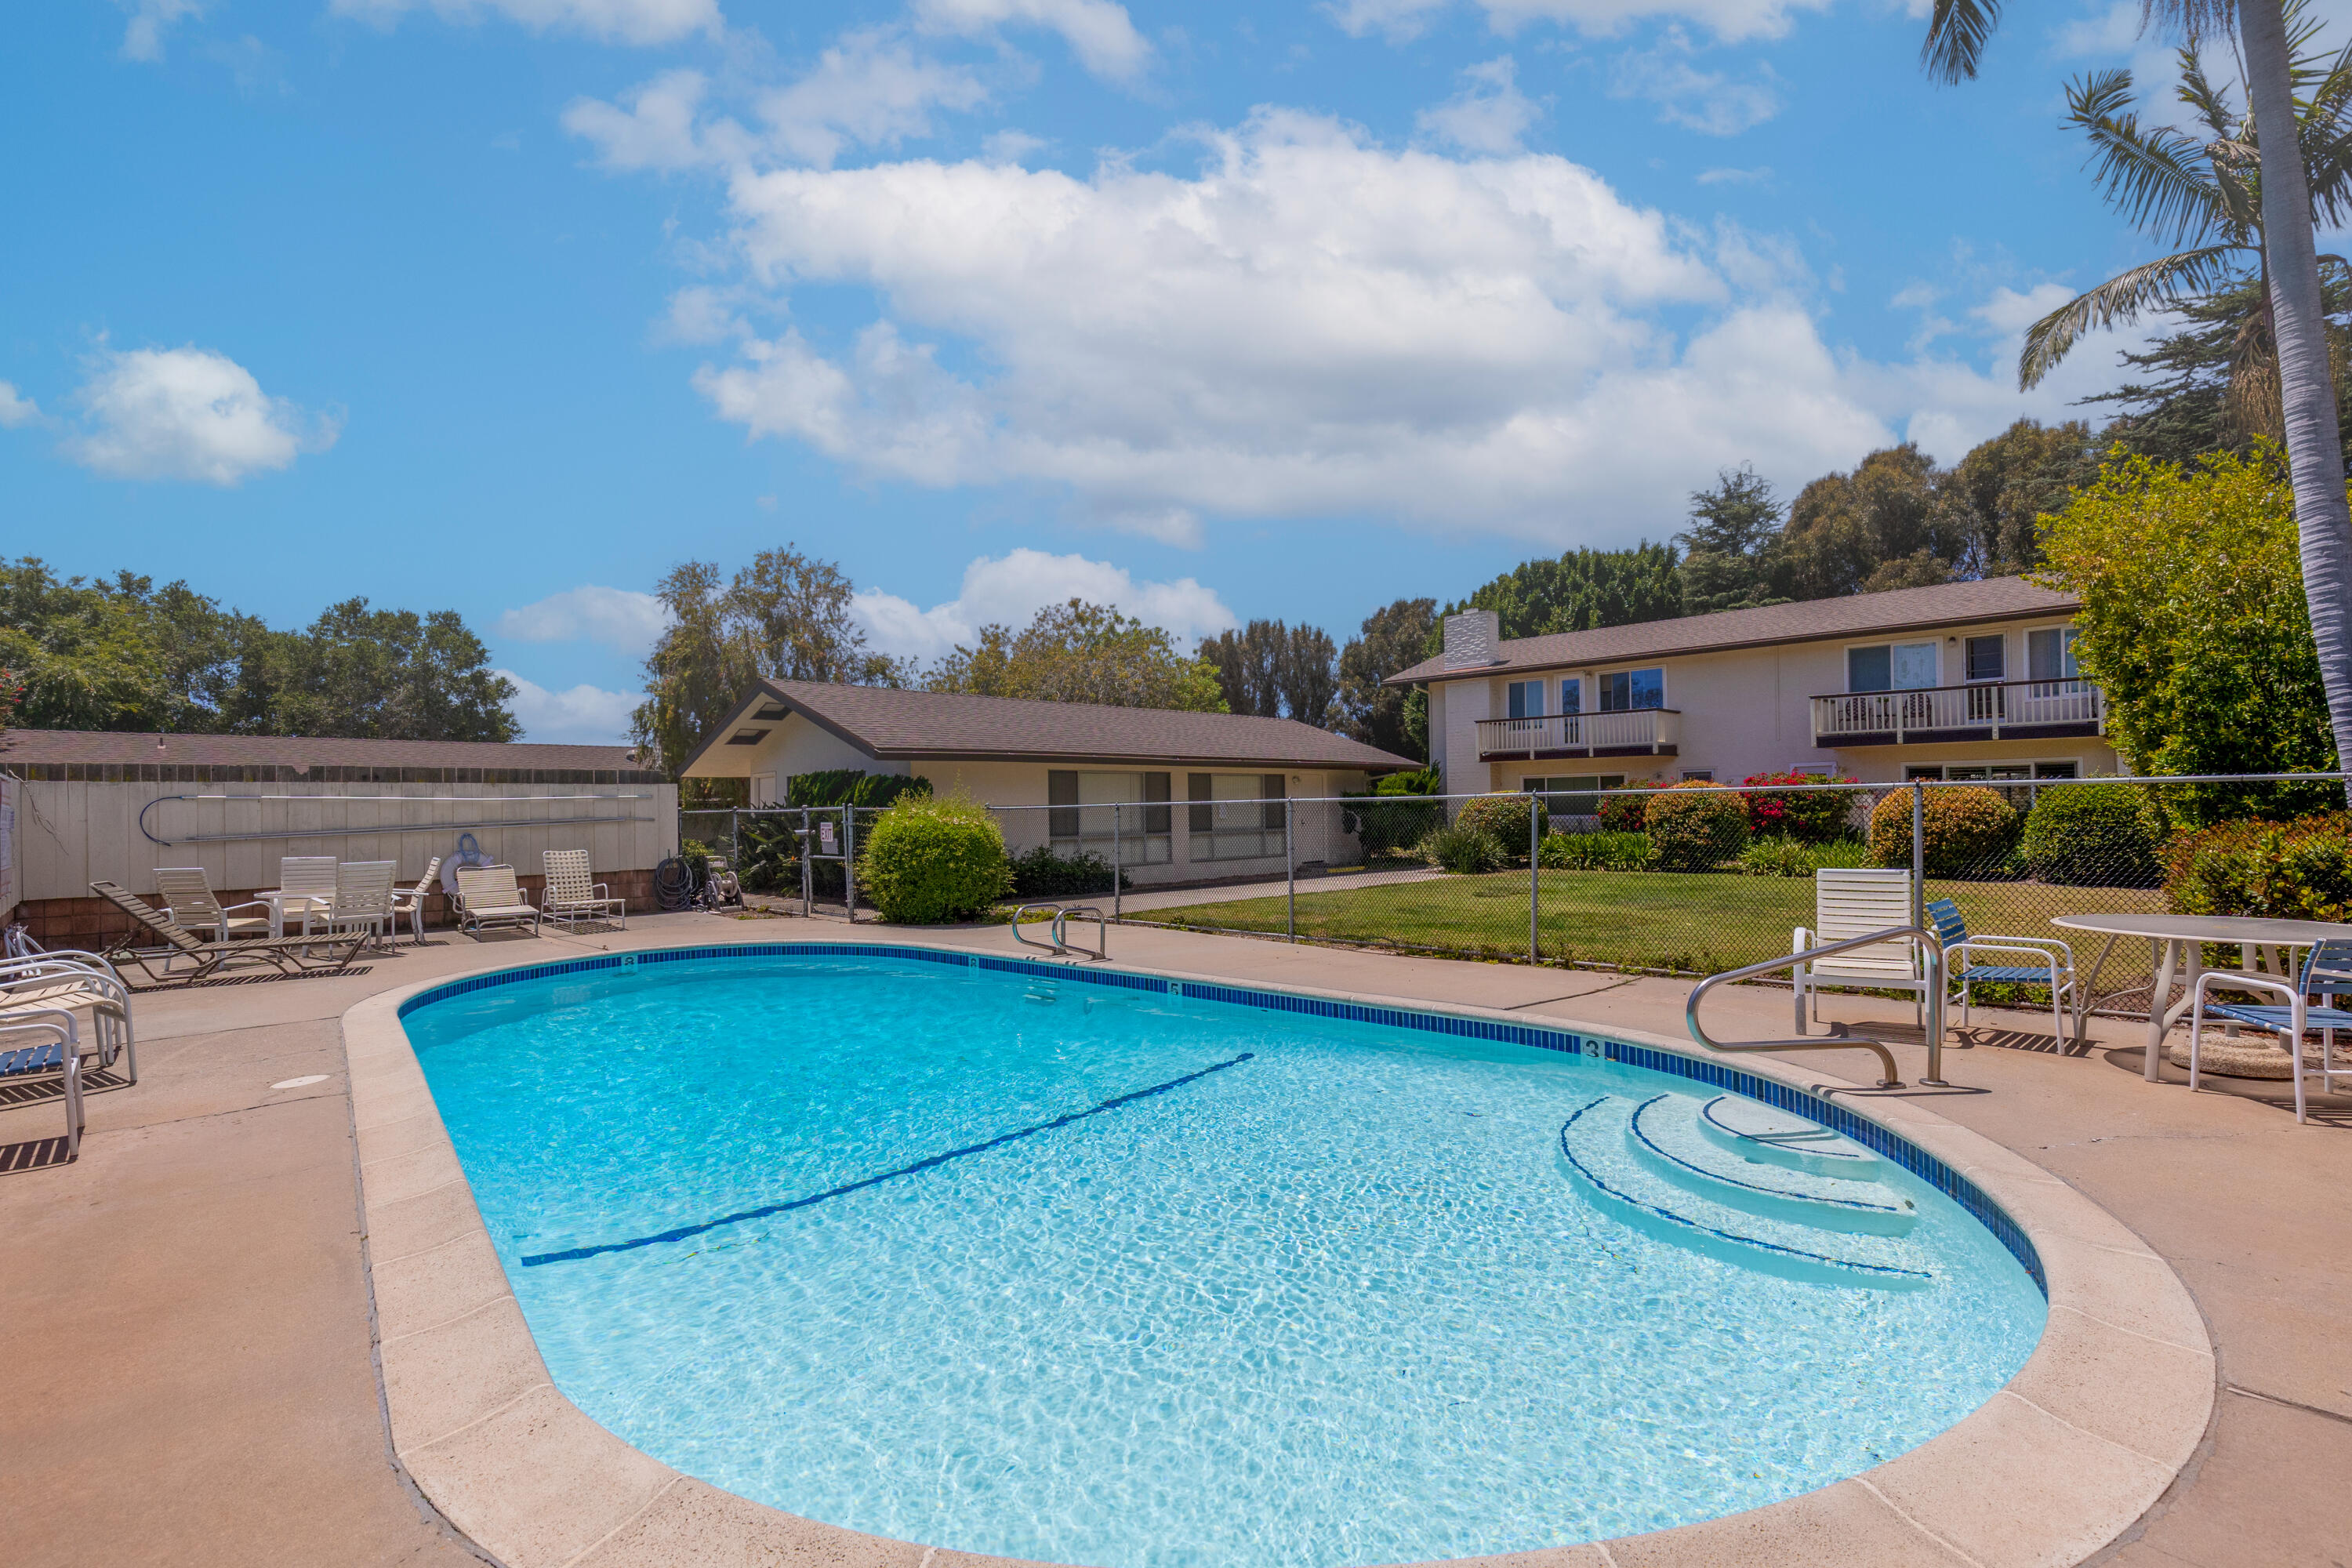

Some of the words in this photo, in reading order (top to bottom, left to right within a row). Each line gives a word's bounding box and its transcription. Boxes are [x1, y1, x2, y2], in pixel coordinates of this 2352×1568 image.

[821, 828, 832, 840] EXIT
[1171, 983, 1178, 995] 5
[1585, 1040, 1599, 1057] 3
